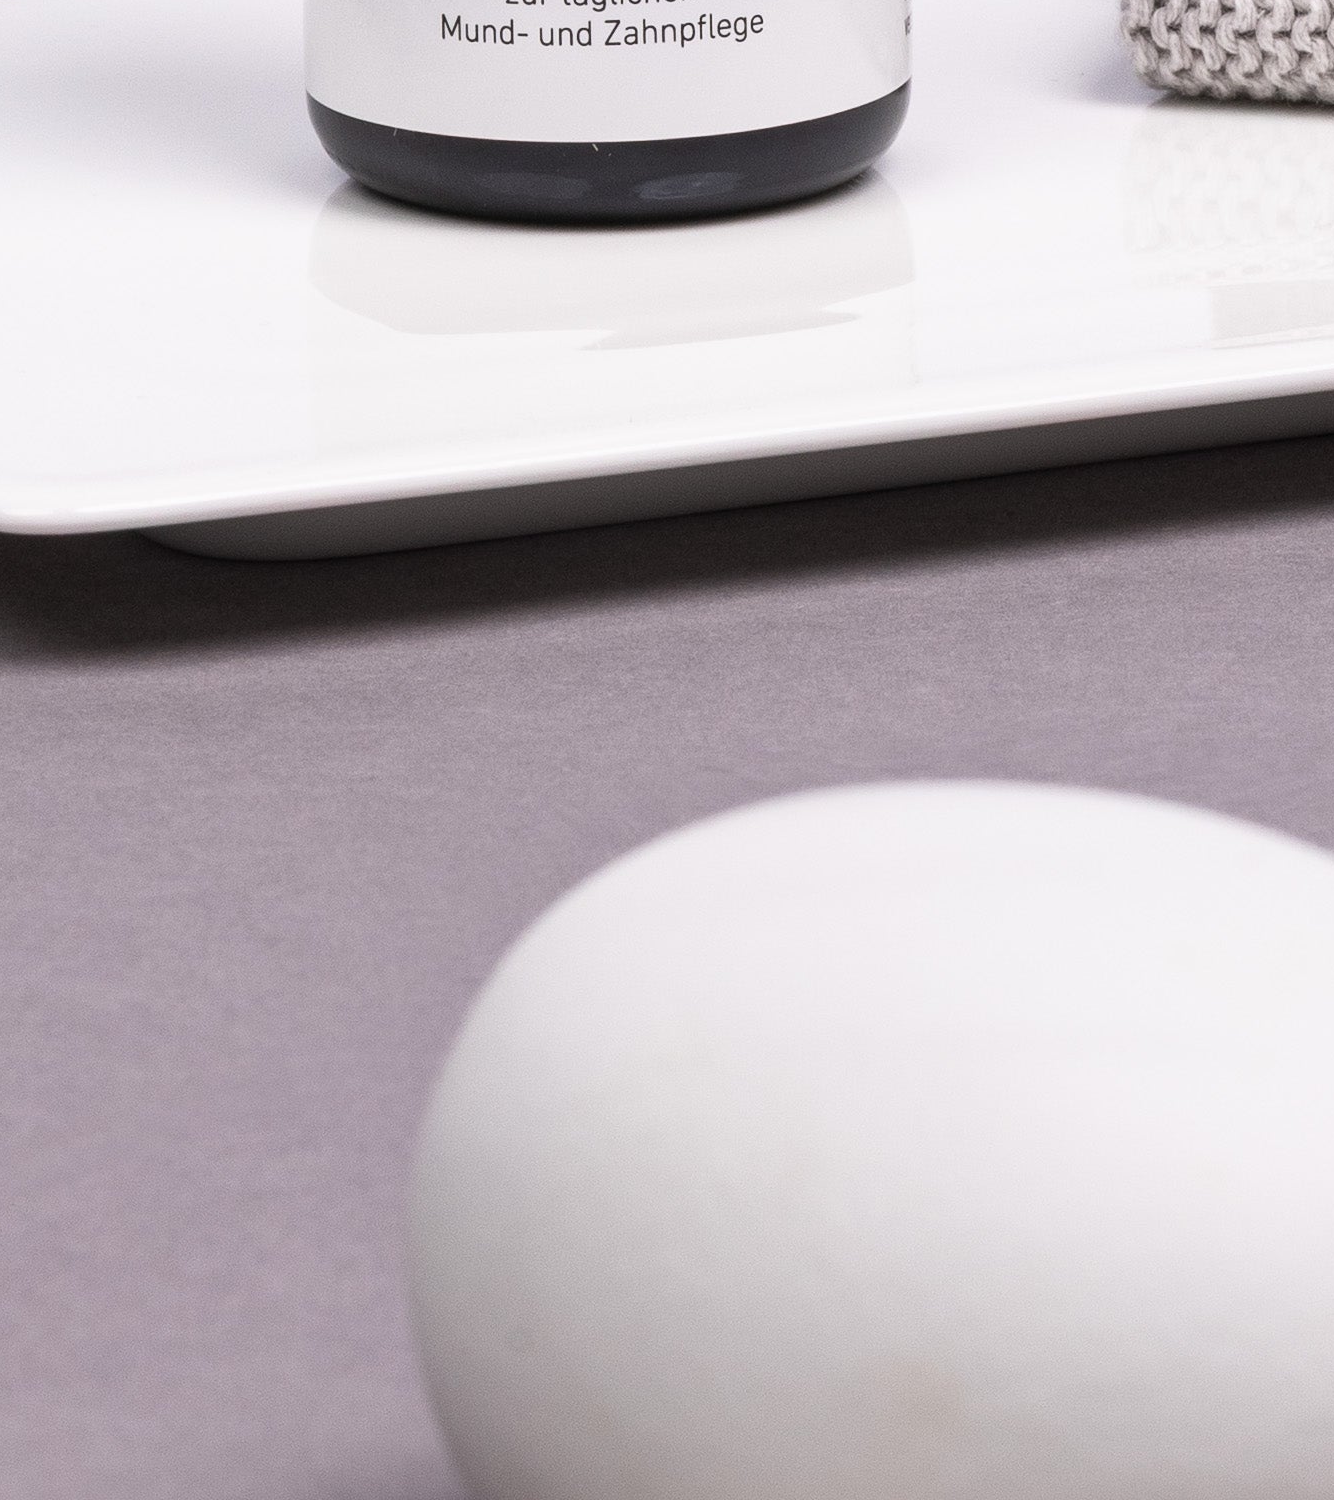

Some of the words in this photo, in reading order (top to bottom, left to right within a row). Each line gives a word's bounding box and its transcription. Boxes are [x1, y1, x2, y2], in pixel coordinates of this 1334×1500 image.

[440, 13, 529, 46] Mund-
[538, 20, 593, 48] und
[604, 12, 765, 49] Zahnpflege
